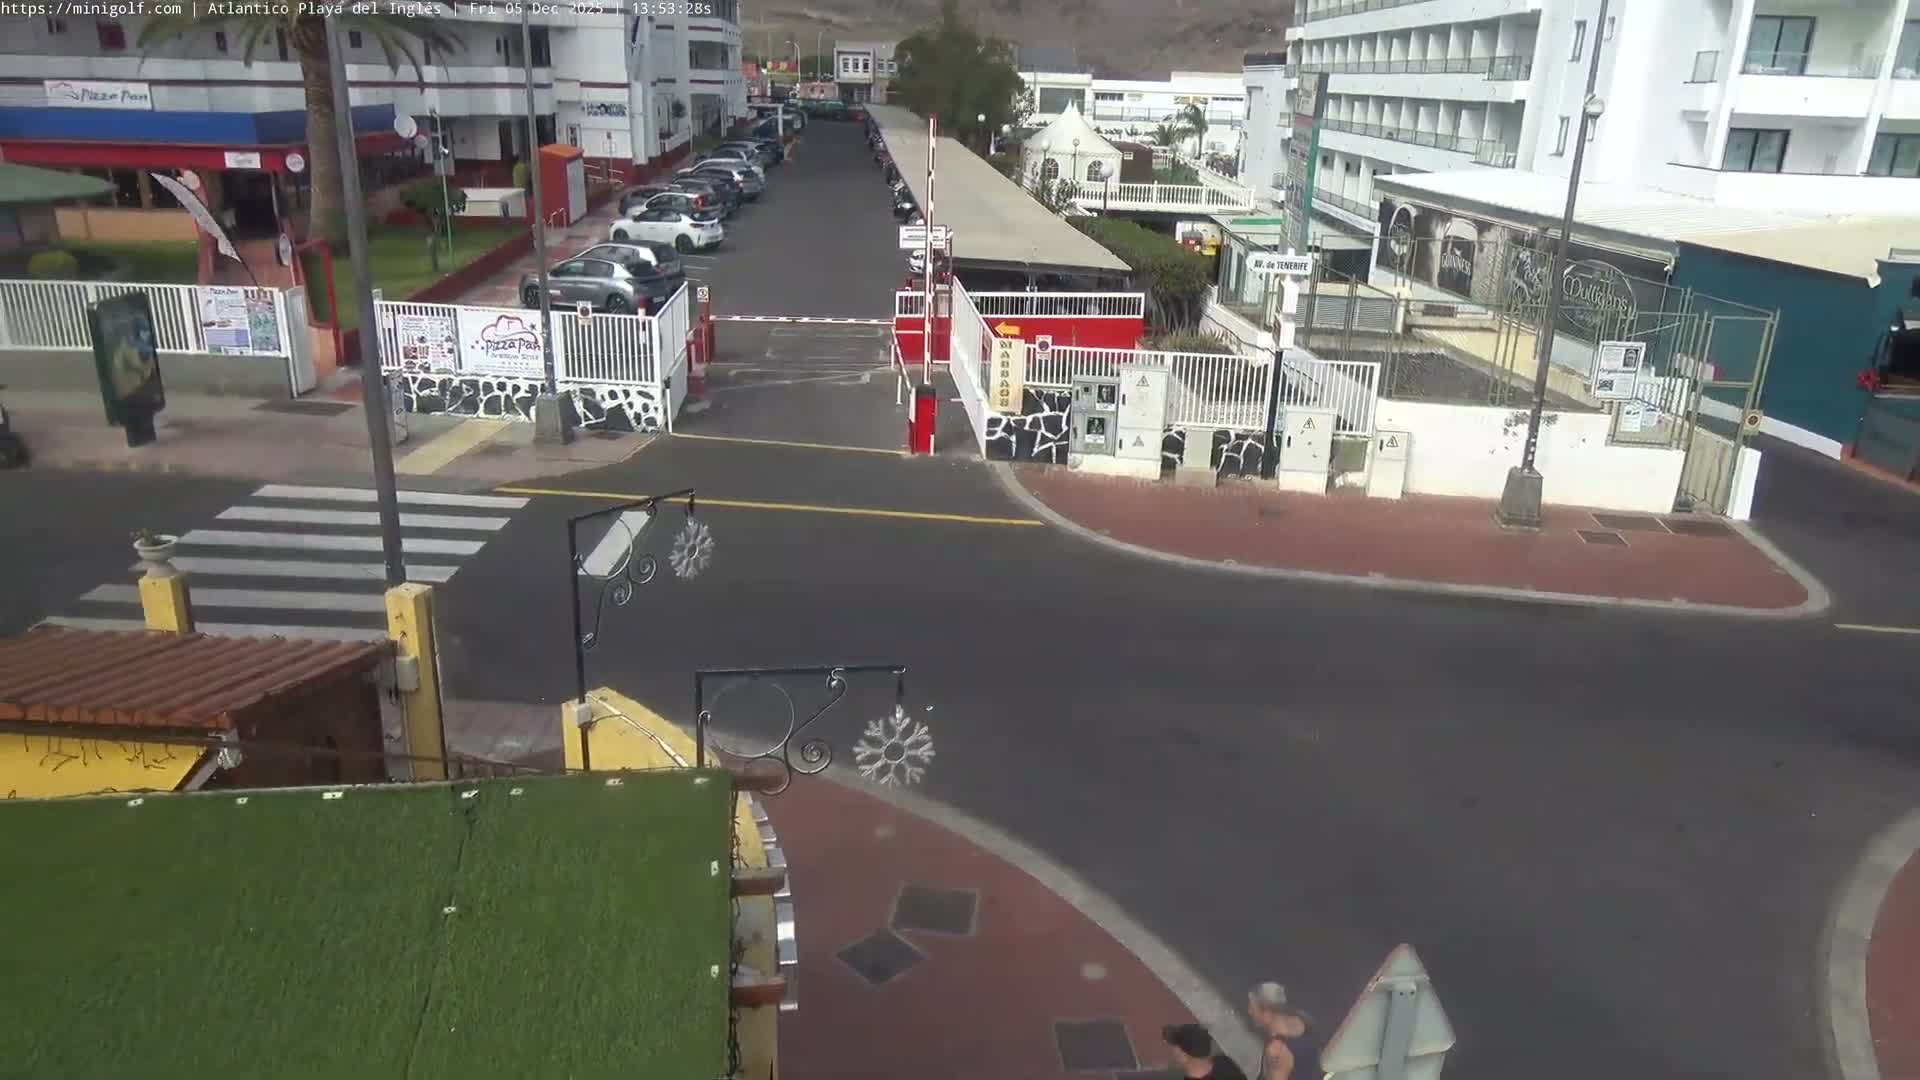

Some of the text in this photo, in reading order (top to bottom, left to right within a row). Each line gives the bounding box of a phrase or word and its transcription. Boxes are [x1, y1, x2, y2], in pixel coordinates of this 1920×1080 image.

[1266, 260, 1275, 270] de
[1277, 260, 1309, 272] TENERIFE
[1441, 252, 1472, 276] GUINNESS
